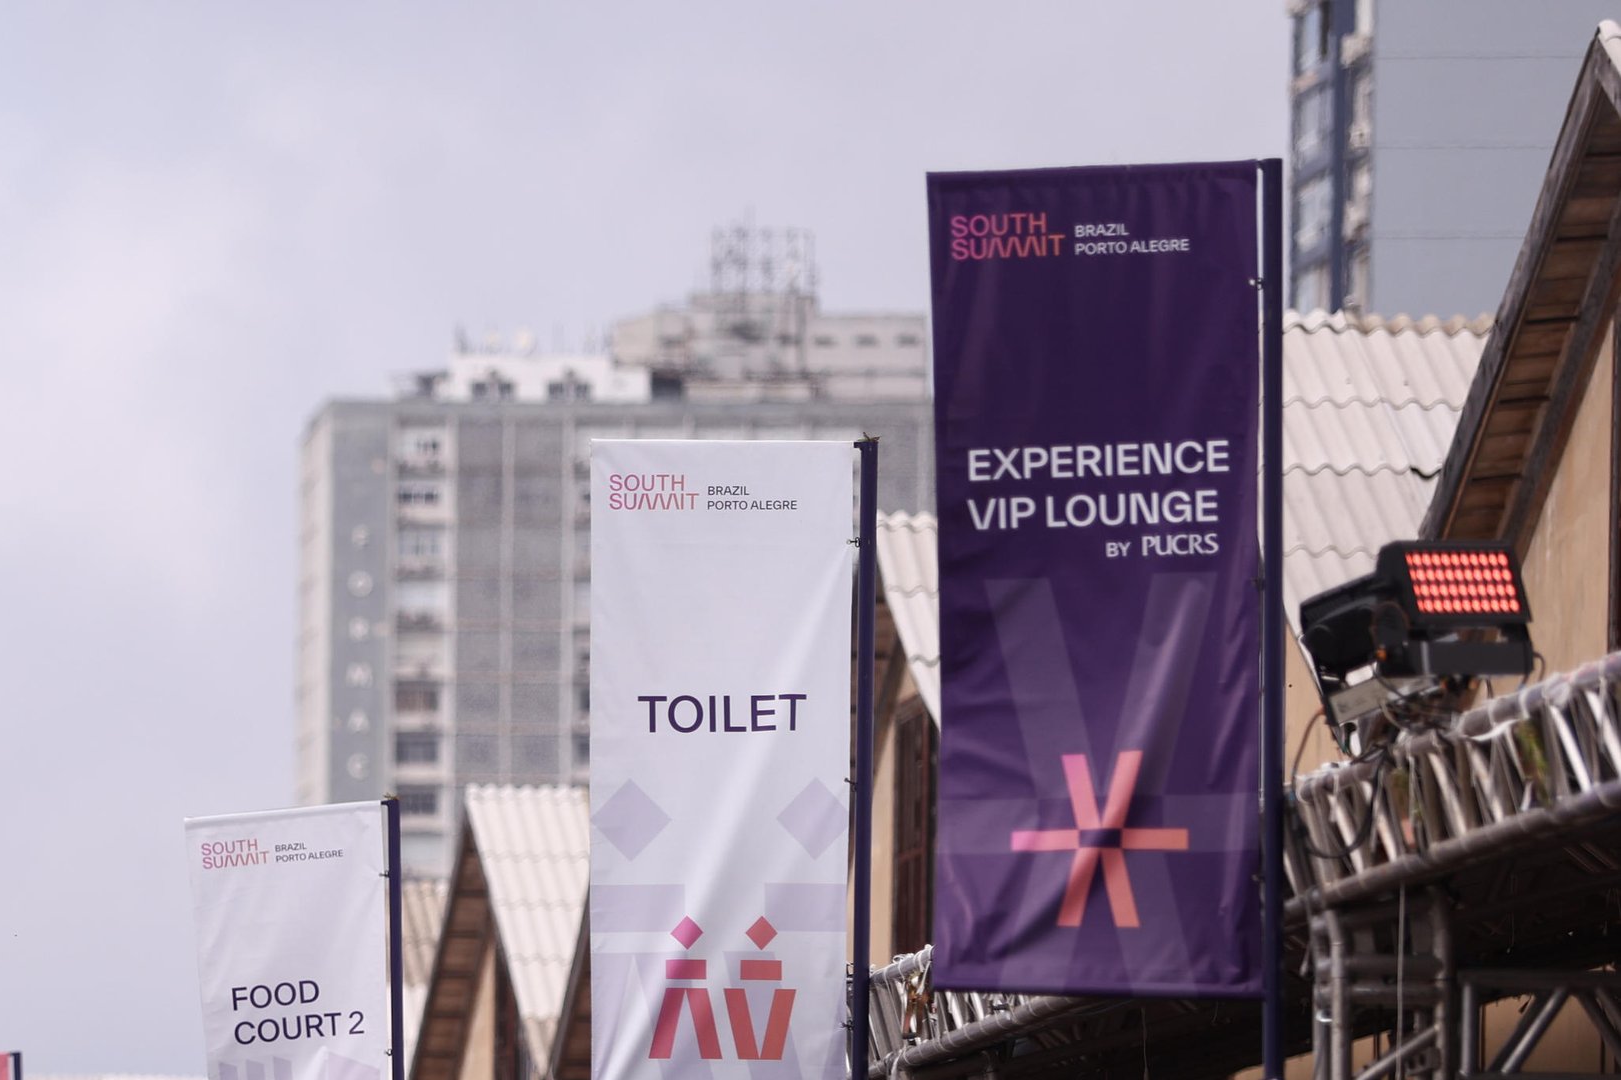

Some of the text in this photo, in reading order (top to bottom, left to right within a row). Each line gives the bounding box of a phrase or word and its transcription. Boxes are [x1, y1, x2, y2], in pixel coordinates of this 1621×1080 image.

[950, 212, 1047, 238] SOUTH
[1074, 223, 1130, 238] BRAZIL
[950, 234, 1066, 260] SUMMIT
[1074, 238, 1191, 256] PORTO ALEGRE
[967, 439, 1231, 482] EXPERIENCE
[609, 474, 685, 492] SOUTH
[707, 485, 750, 496] BRAZIL
[609, 492, 700, 511] SUMMIT
[707, 500, 798, 511] PORTO ALEGRE
[966, 489, 1219, 531] VIP LOUNGE
[1105, 533, 1220, 558] BY PUCRS
[637, 693, 808, 733] TOILET
[201, 838, 258, 856] SOUTH
[274, 842, 308, 853] BRAZIL
[275, 849, 344, 863] PORTO ALEGRE
[202, 850, 270, 870] SUMMIT
[231, 979, 320, 1011] FOOD
[234, 1010, 365, 1045] COURT 2
